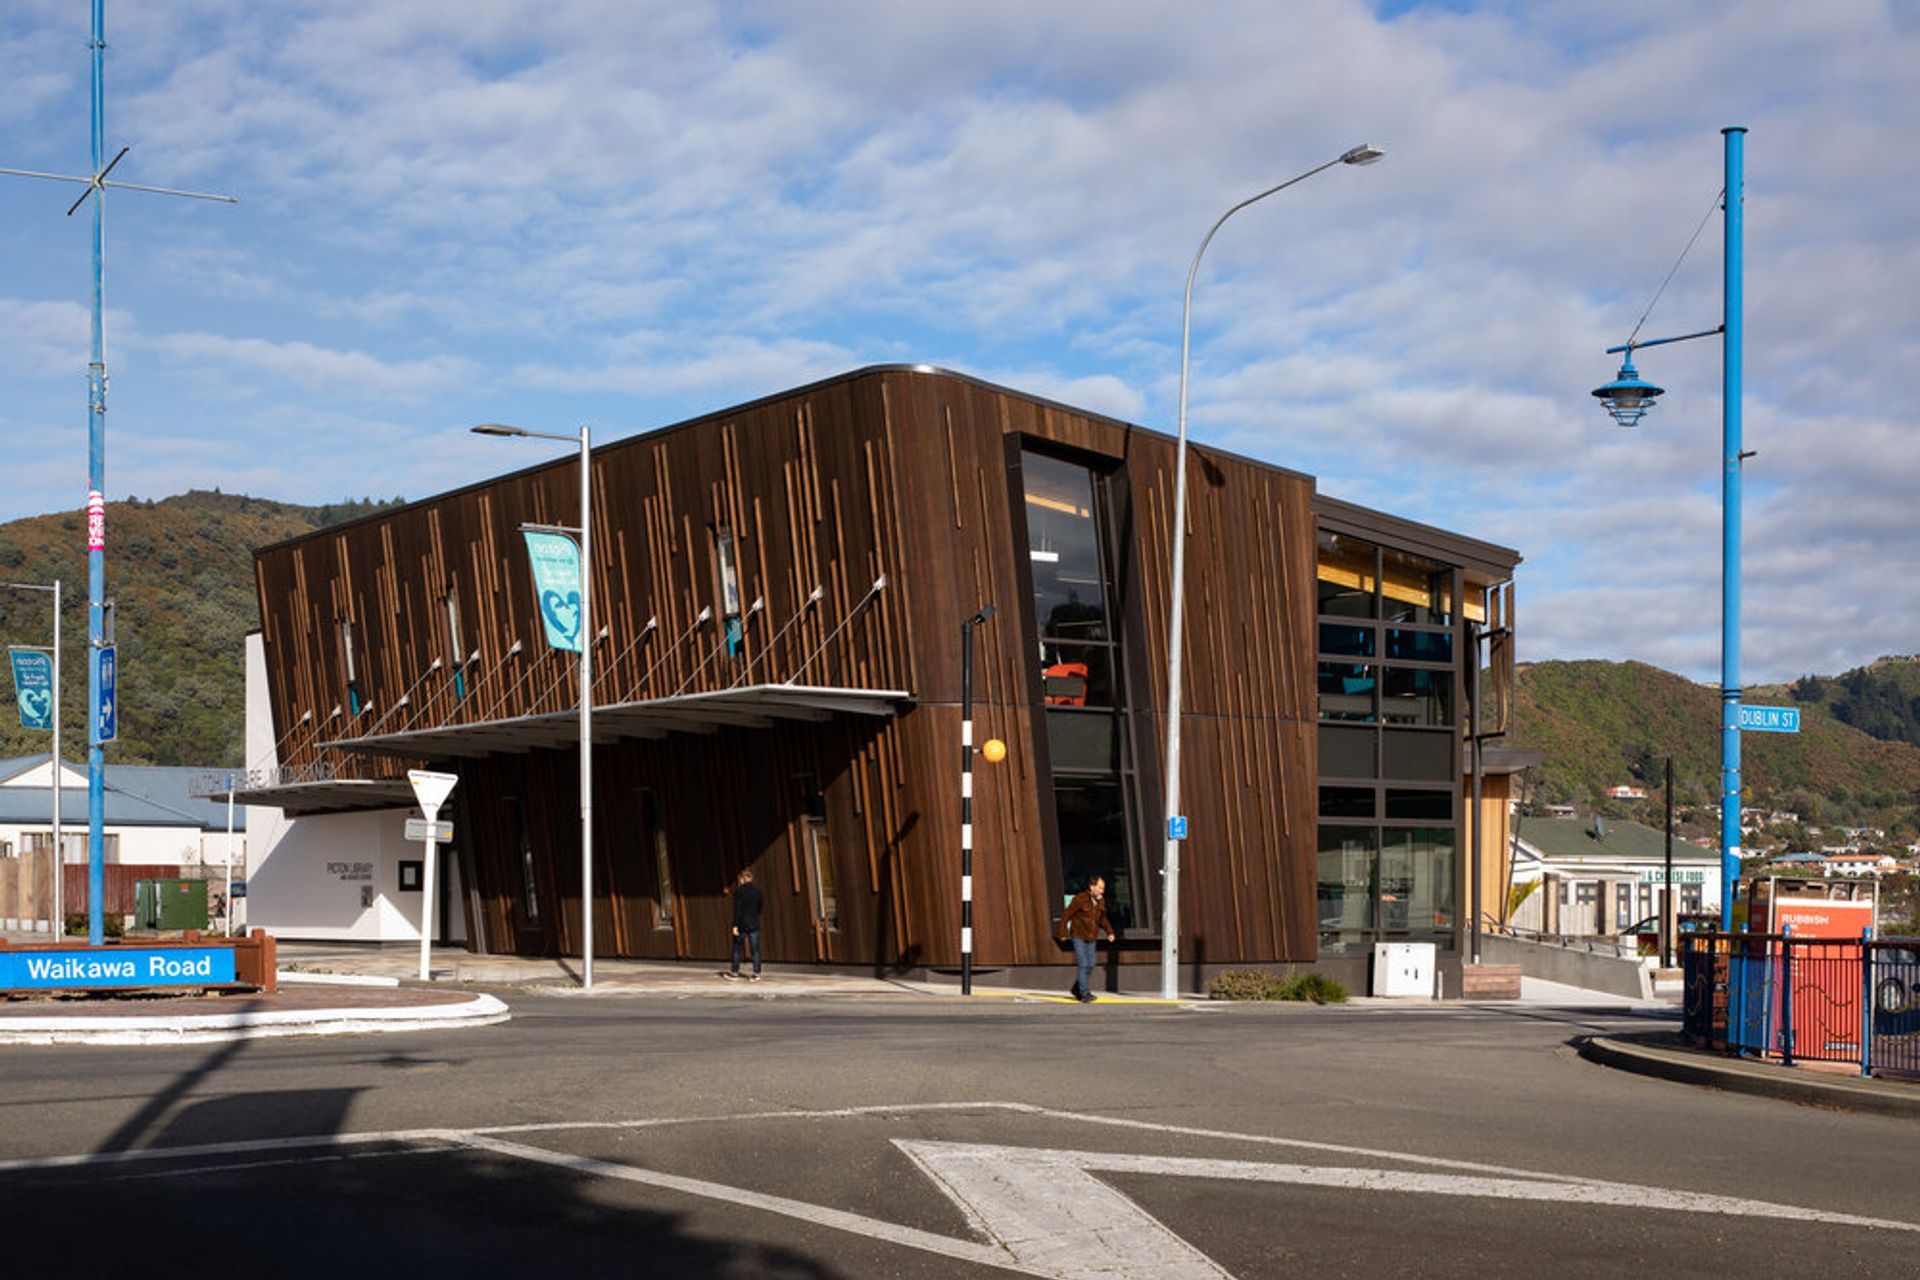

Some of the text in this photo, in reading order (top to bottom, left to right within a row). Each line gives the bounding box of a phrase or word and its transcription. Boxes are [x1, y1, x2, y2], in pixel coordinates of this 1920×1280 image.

[1741, 709, 1794, 727] DUBLIN ST
[1655, 869, 1684, 881] CHESE
[1781, 913, 1830, 925] RUBBISH
[27, 956, 211, 980] Waikawa Road
